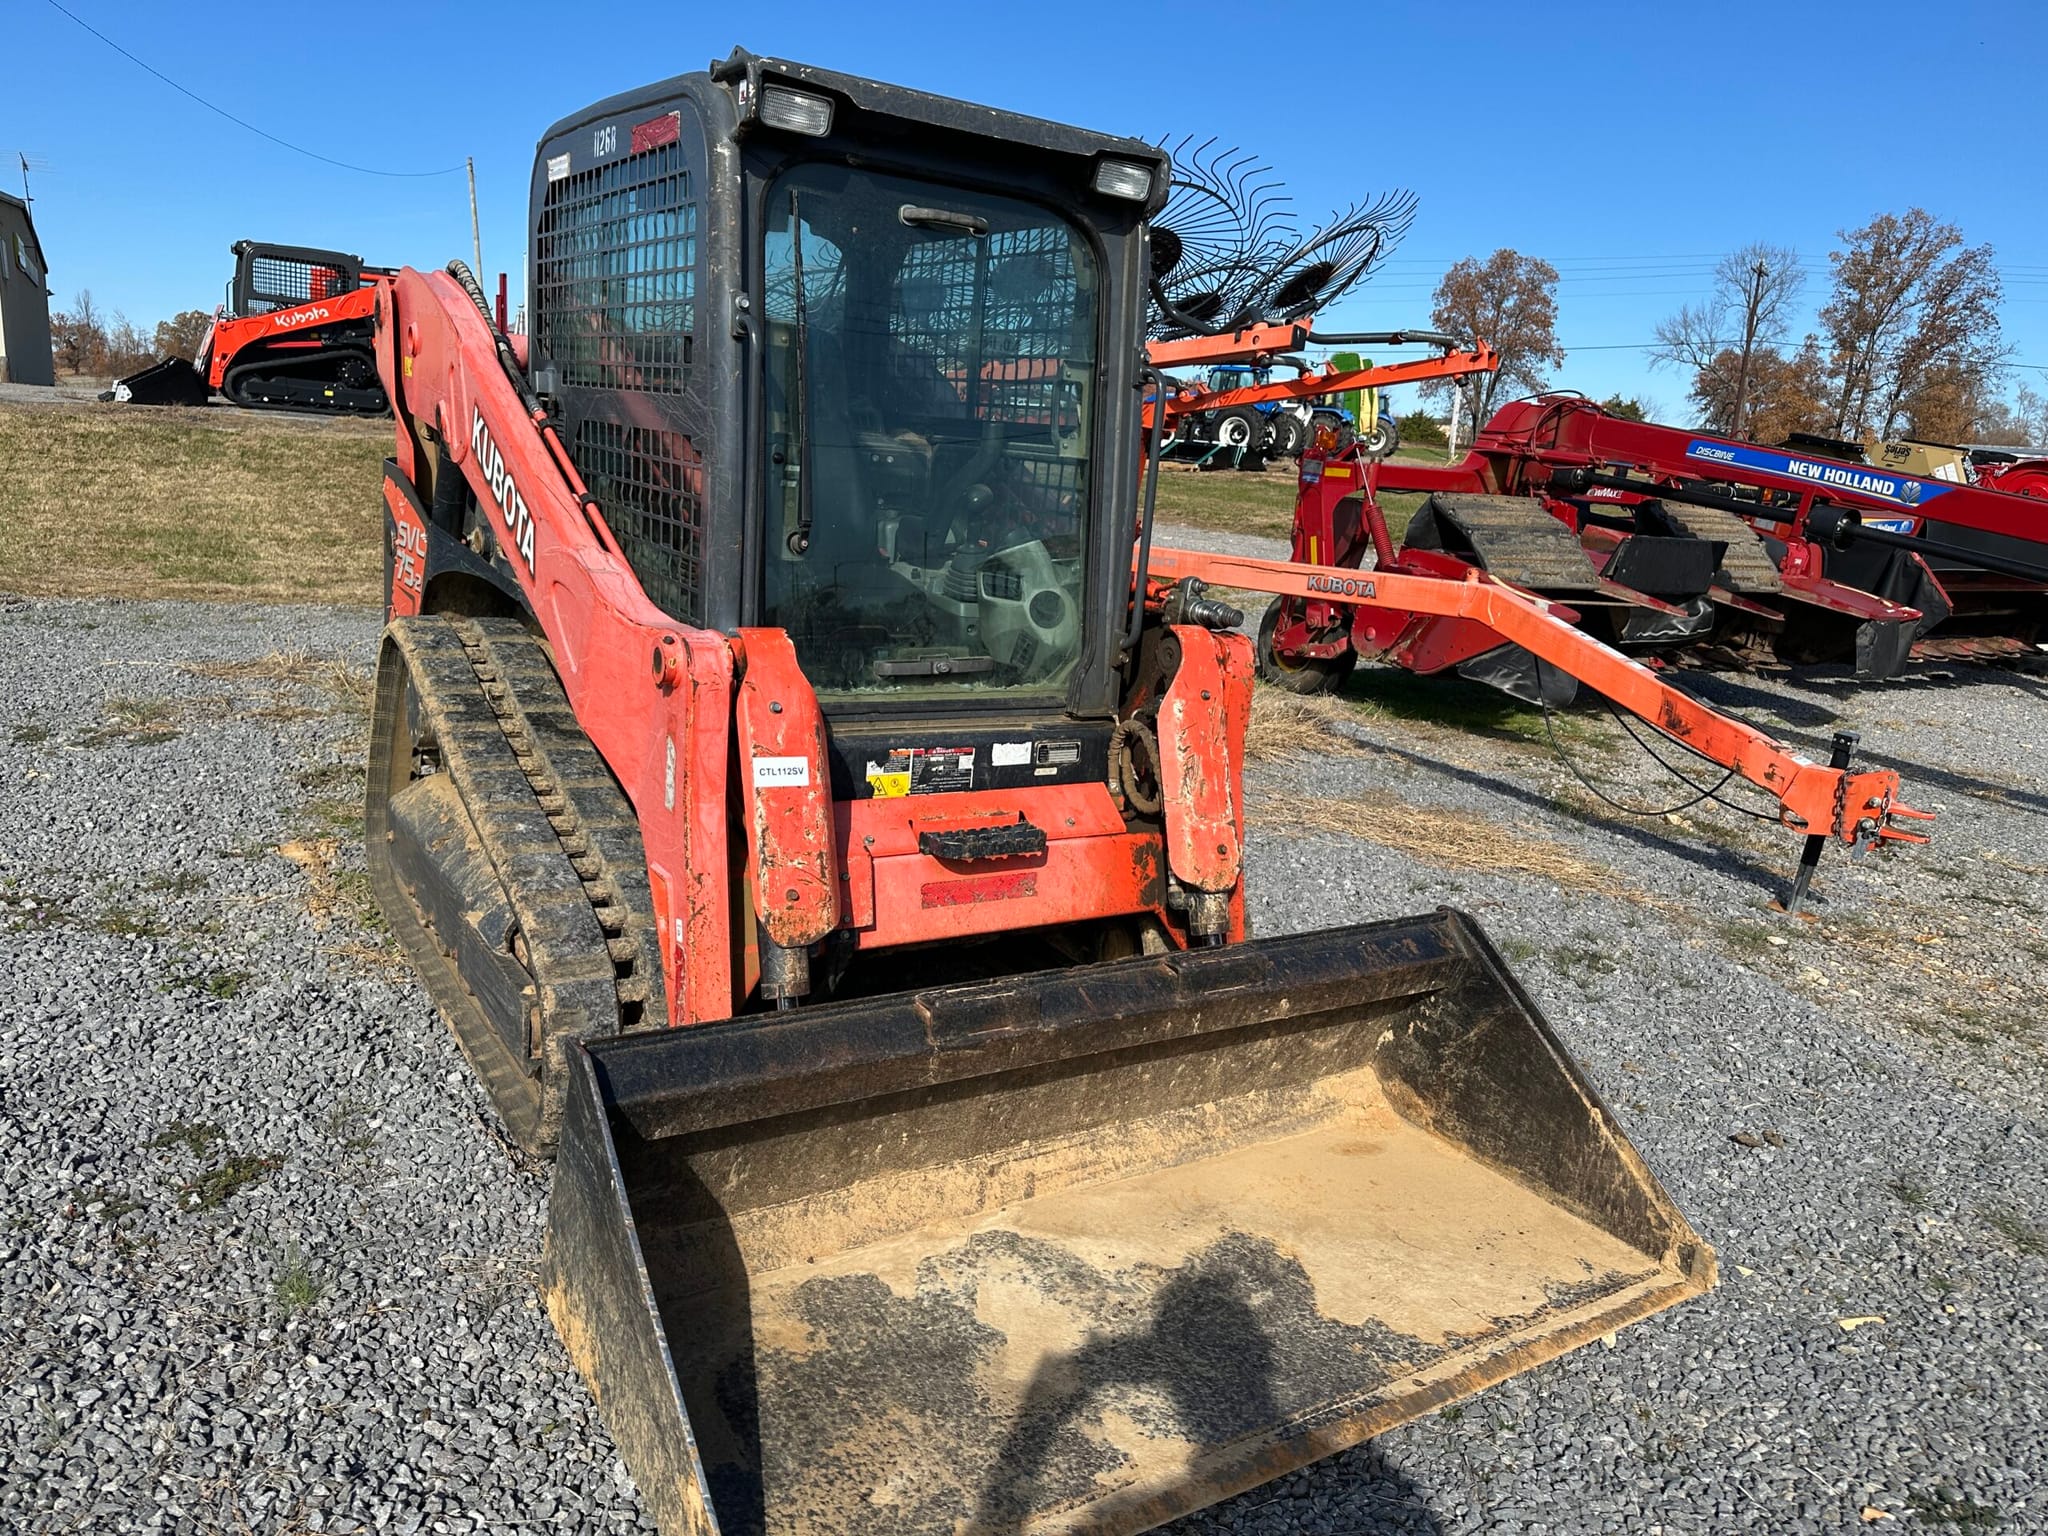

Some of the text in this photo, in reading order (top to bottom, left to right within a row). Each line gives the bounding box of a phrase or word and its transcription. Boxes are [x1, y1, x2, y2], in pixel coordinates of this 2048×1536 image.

[594, 125, 616, 158] 11268
[274, 307, 330, 327] Kubota
[471, 404, 536, 577] KUBOTA
[1788, 460, 1895, 496] NEW HOLLAND
[397, 520, 425, 558] SVL
[1307, 575, 1376, 599] KUBOTA
[759, 767, 804, 781] CTL112SV
